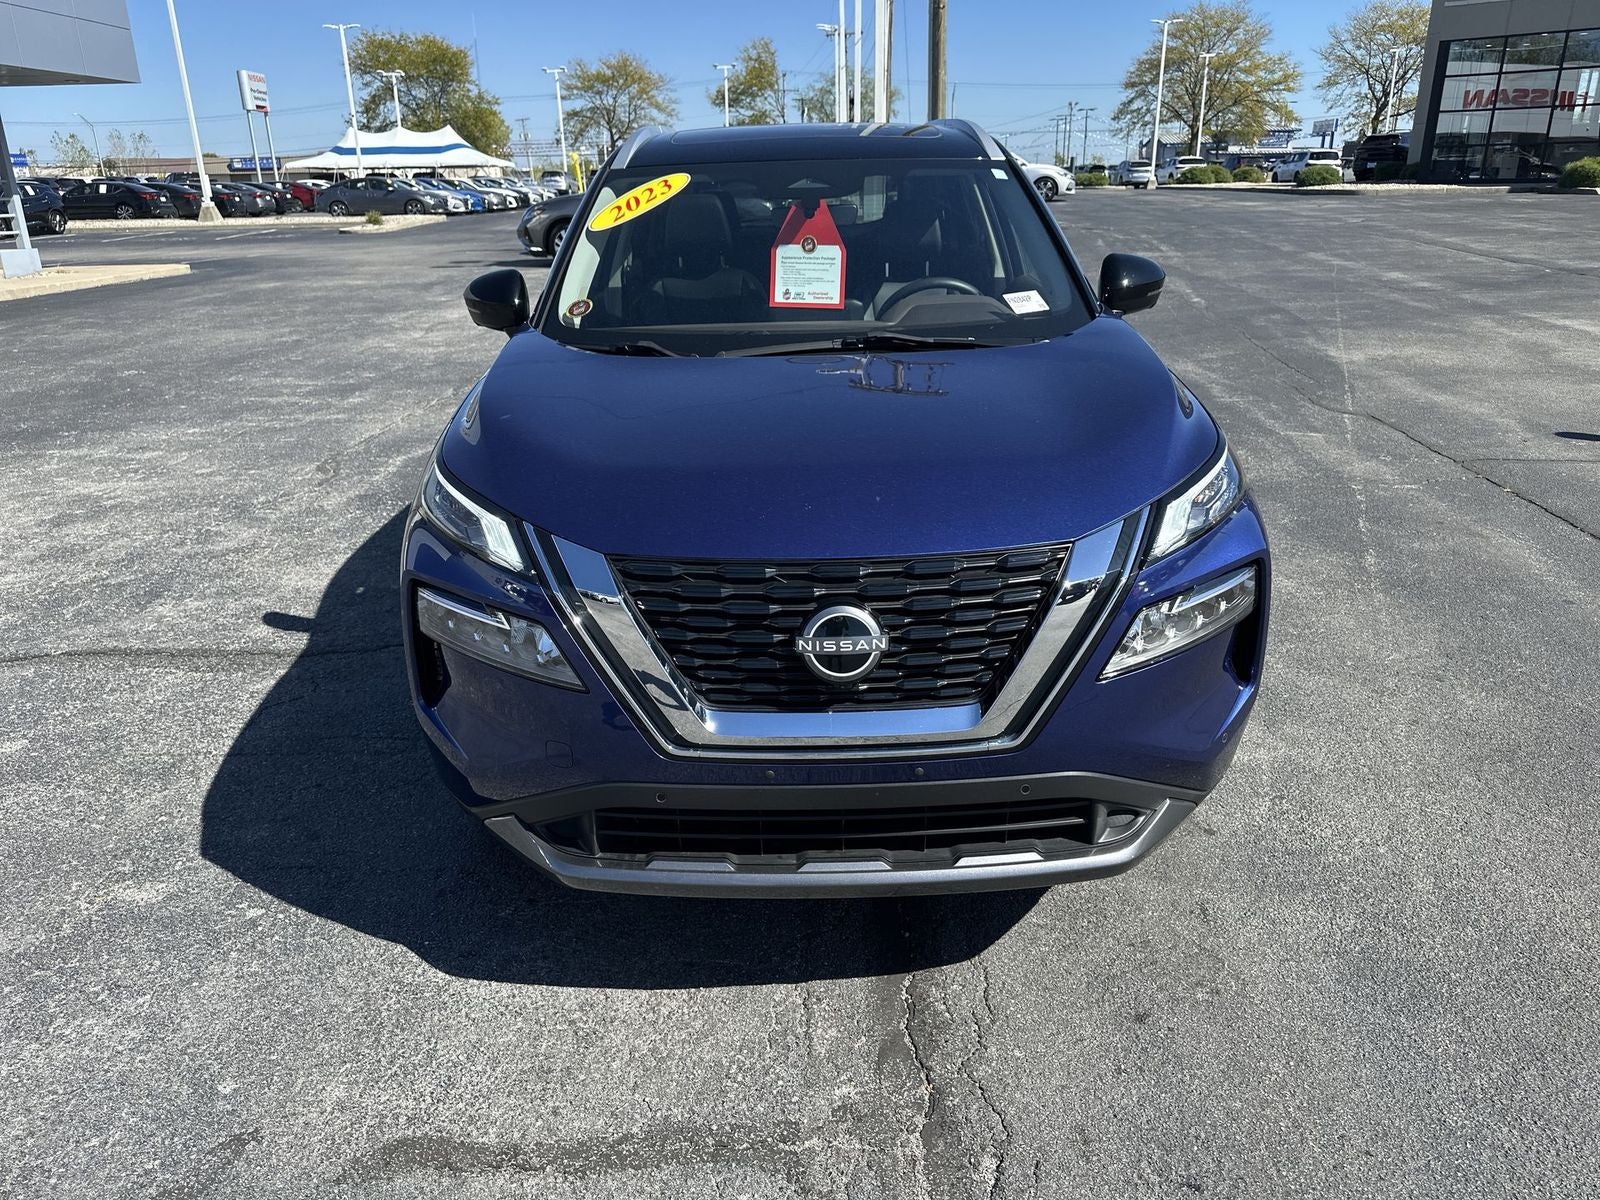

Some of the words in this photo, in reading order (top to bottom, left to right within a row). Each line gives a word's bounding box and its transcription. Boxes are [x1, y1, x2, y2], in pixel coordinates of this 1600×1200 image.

[248, 74, 266, 84] NISSAN
[609, 179, 673, 223] 2023
[798, 637, 886, 652] NISSAN
